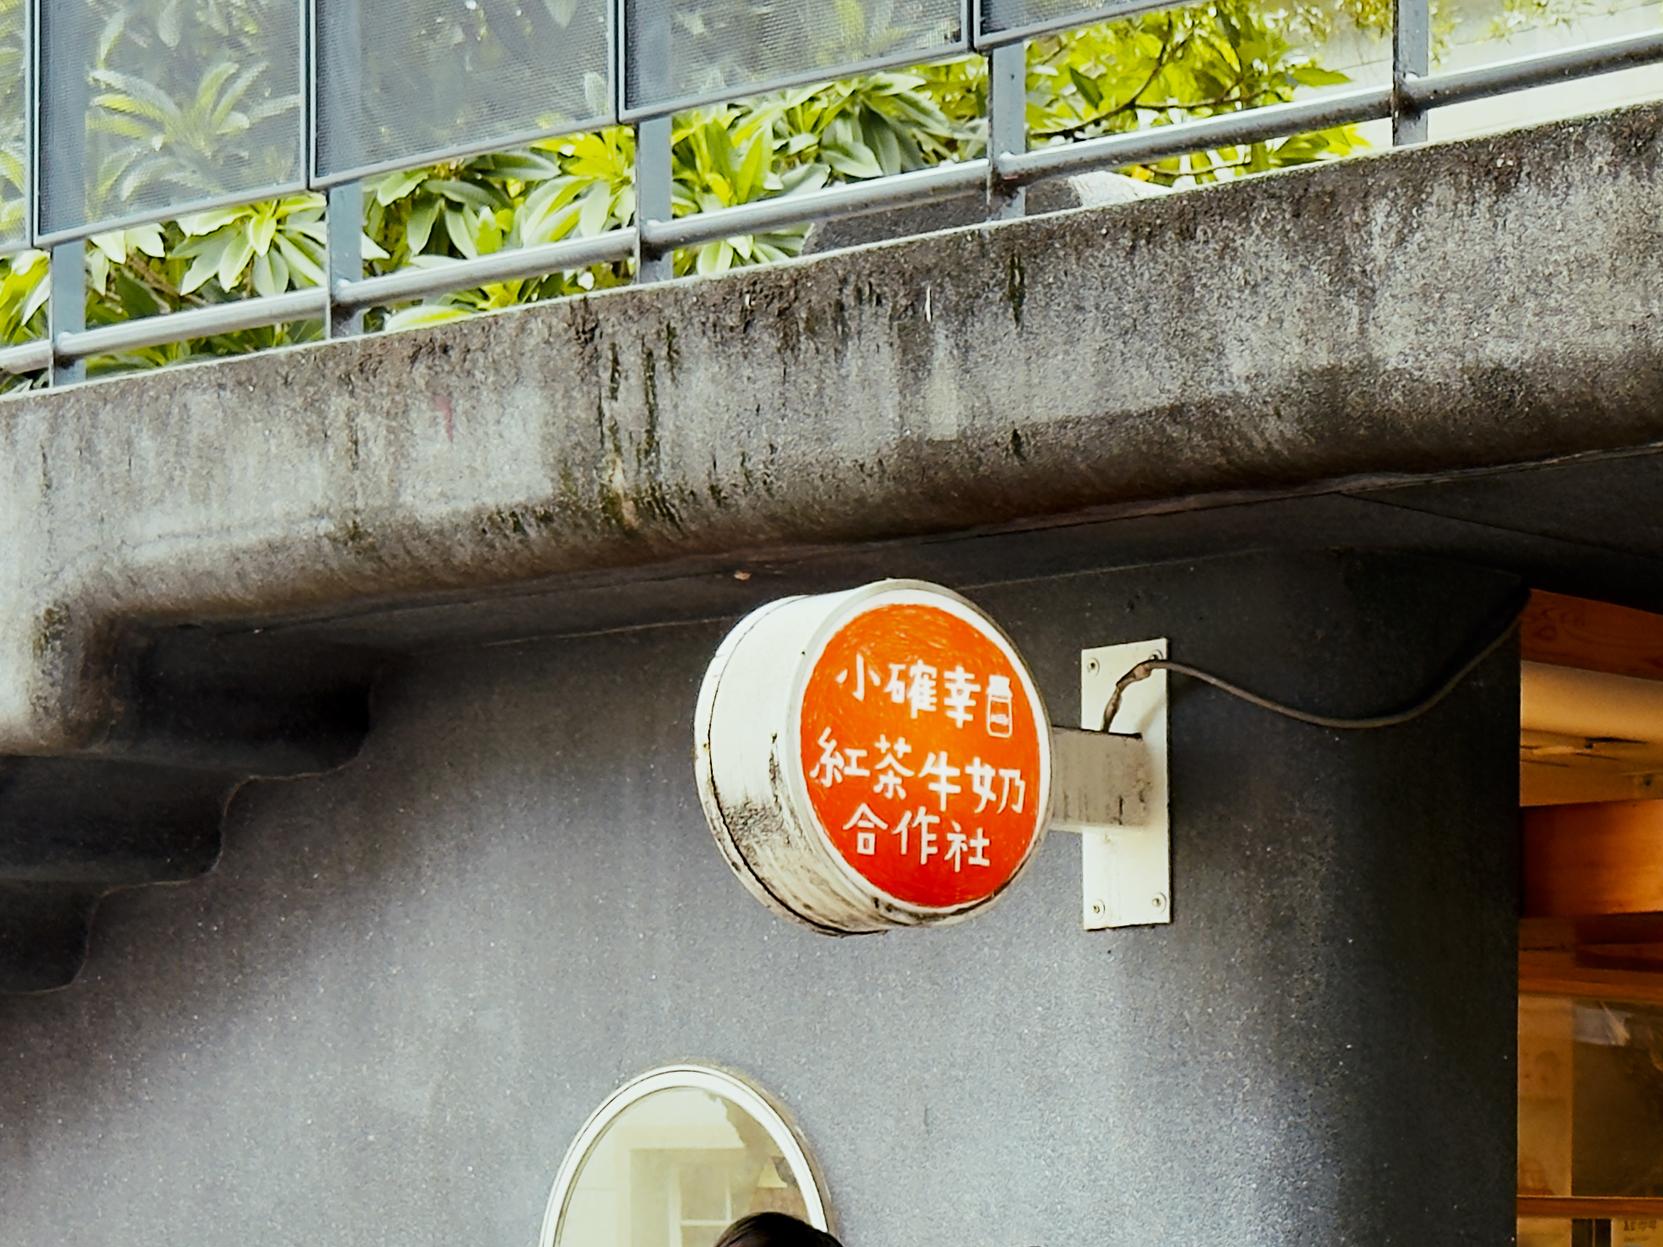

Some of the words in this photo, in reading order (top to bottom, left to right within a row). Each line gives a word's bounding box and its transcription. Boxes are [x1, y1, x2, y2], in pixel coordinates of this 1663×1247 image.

[835, 655, 983, 728] 小確幸
[810, 727, 1027, 814] 紅茶牛奶
[843, 803, 991, 873] 合作社
